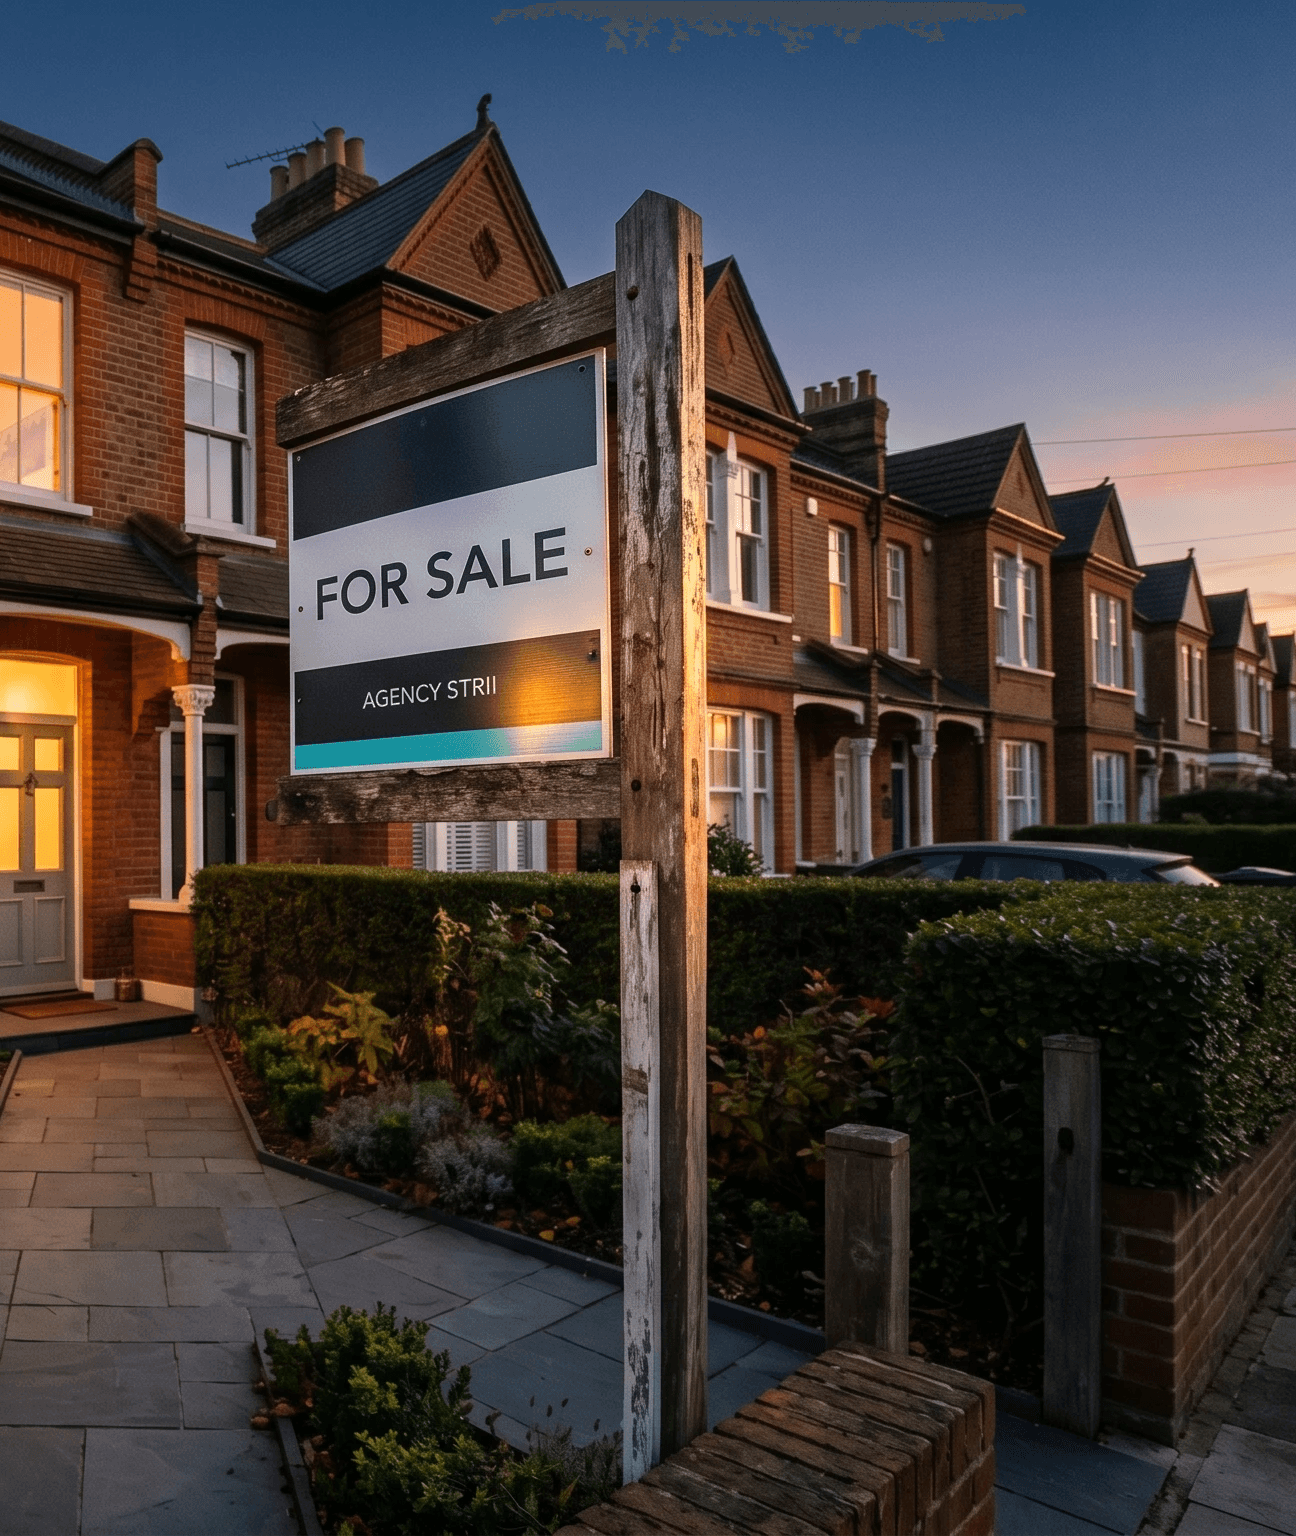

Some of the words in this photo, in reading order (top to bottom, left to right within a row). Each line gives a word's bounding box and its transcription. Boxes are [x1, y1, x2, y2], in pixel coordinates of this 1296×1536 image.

[316, 561, 410, 621] FOR
[426, 526, 569, 600] SALE
[362, 682, 442, 710] AGENCY
